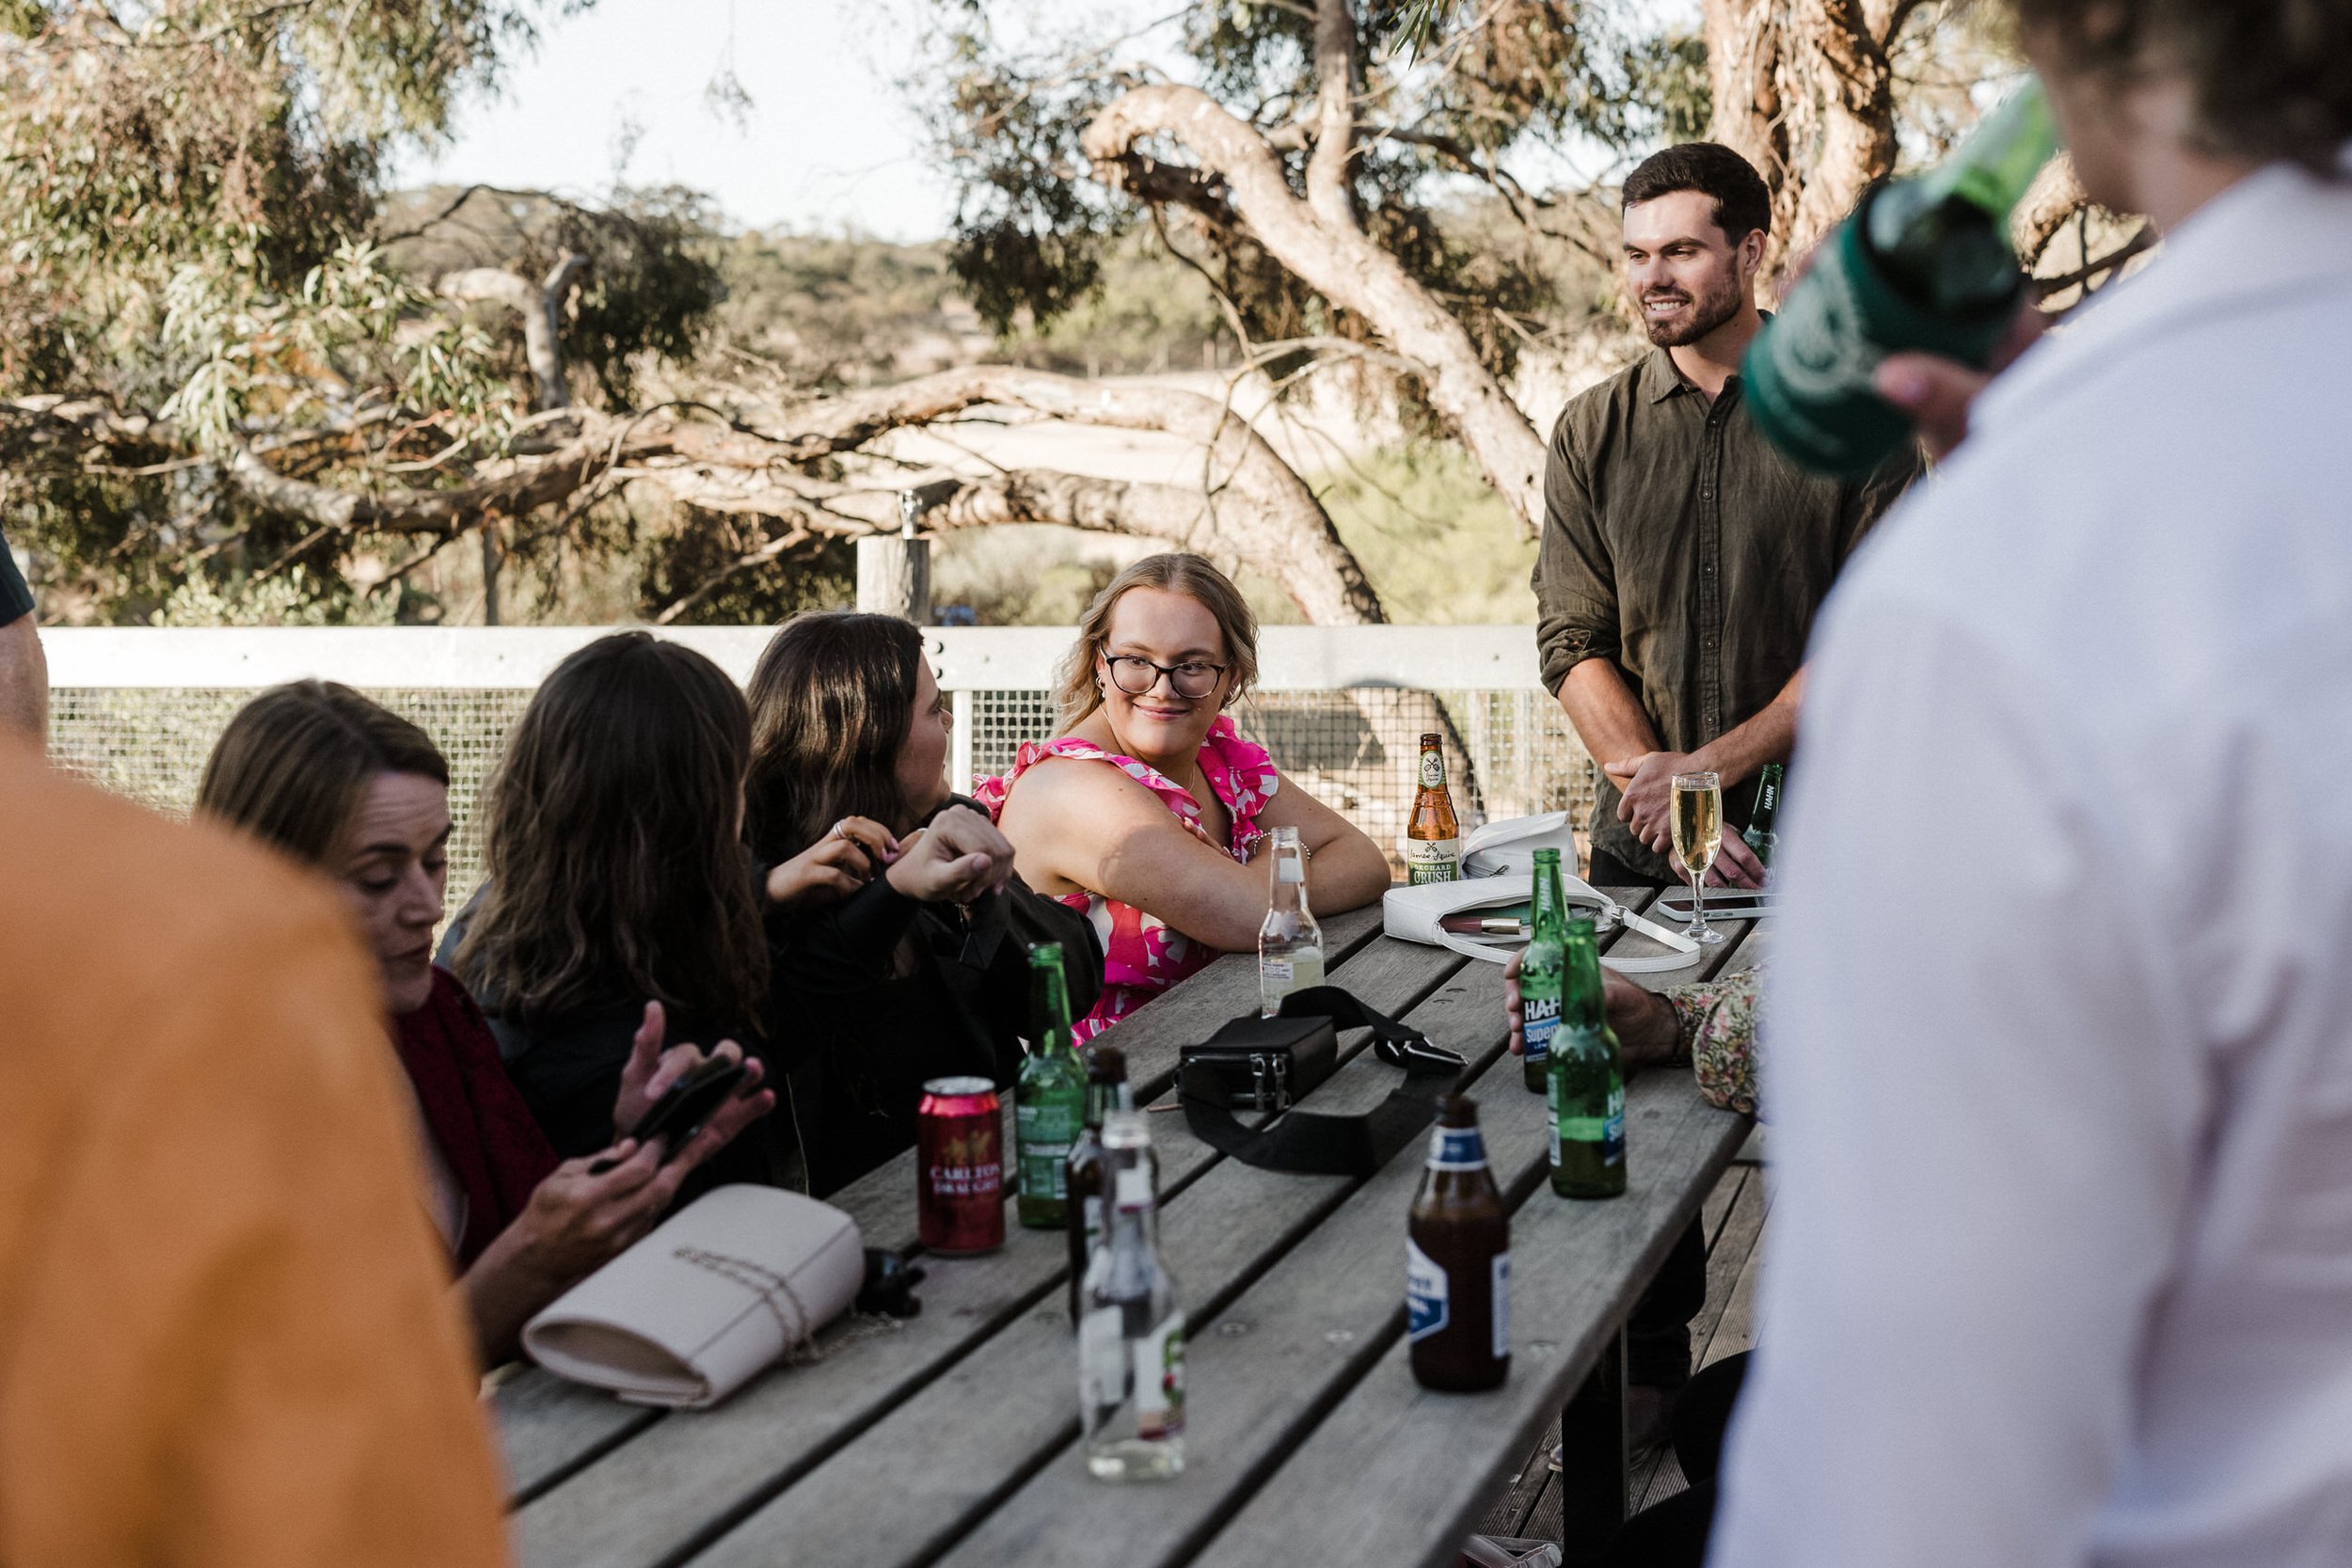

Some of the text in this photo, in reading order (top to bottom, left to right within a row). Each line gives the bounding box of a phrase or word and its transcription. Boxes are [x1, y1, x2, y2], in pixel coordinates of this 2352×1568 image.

[1764, 784, 1774, 810] HAHN
[1413, 870, 1452, 884] CRUSH
[1524, 996, 1563, 1022] HAH
